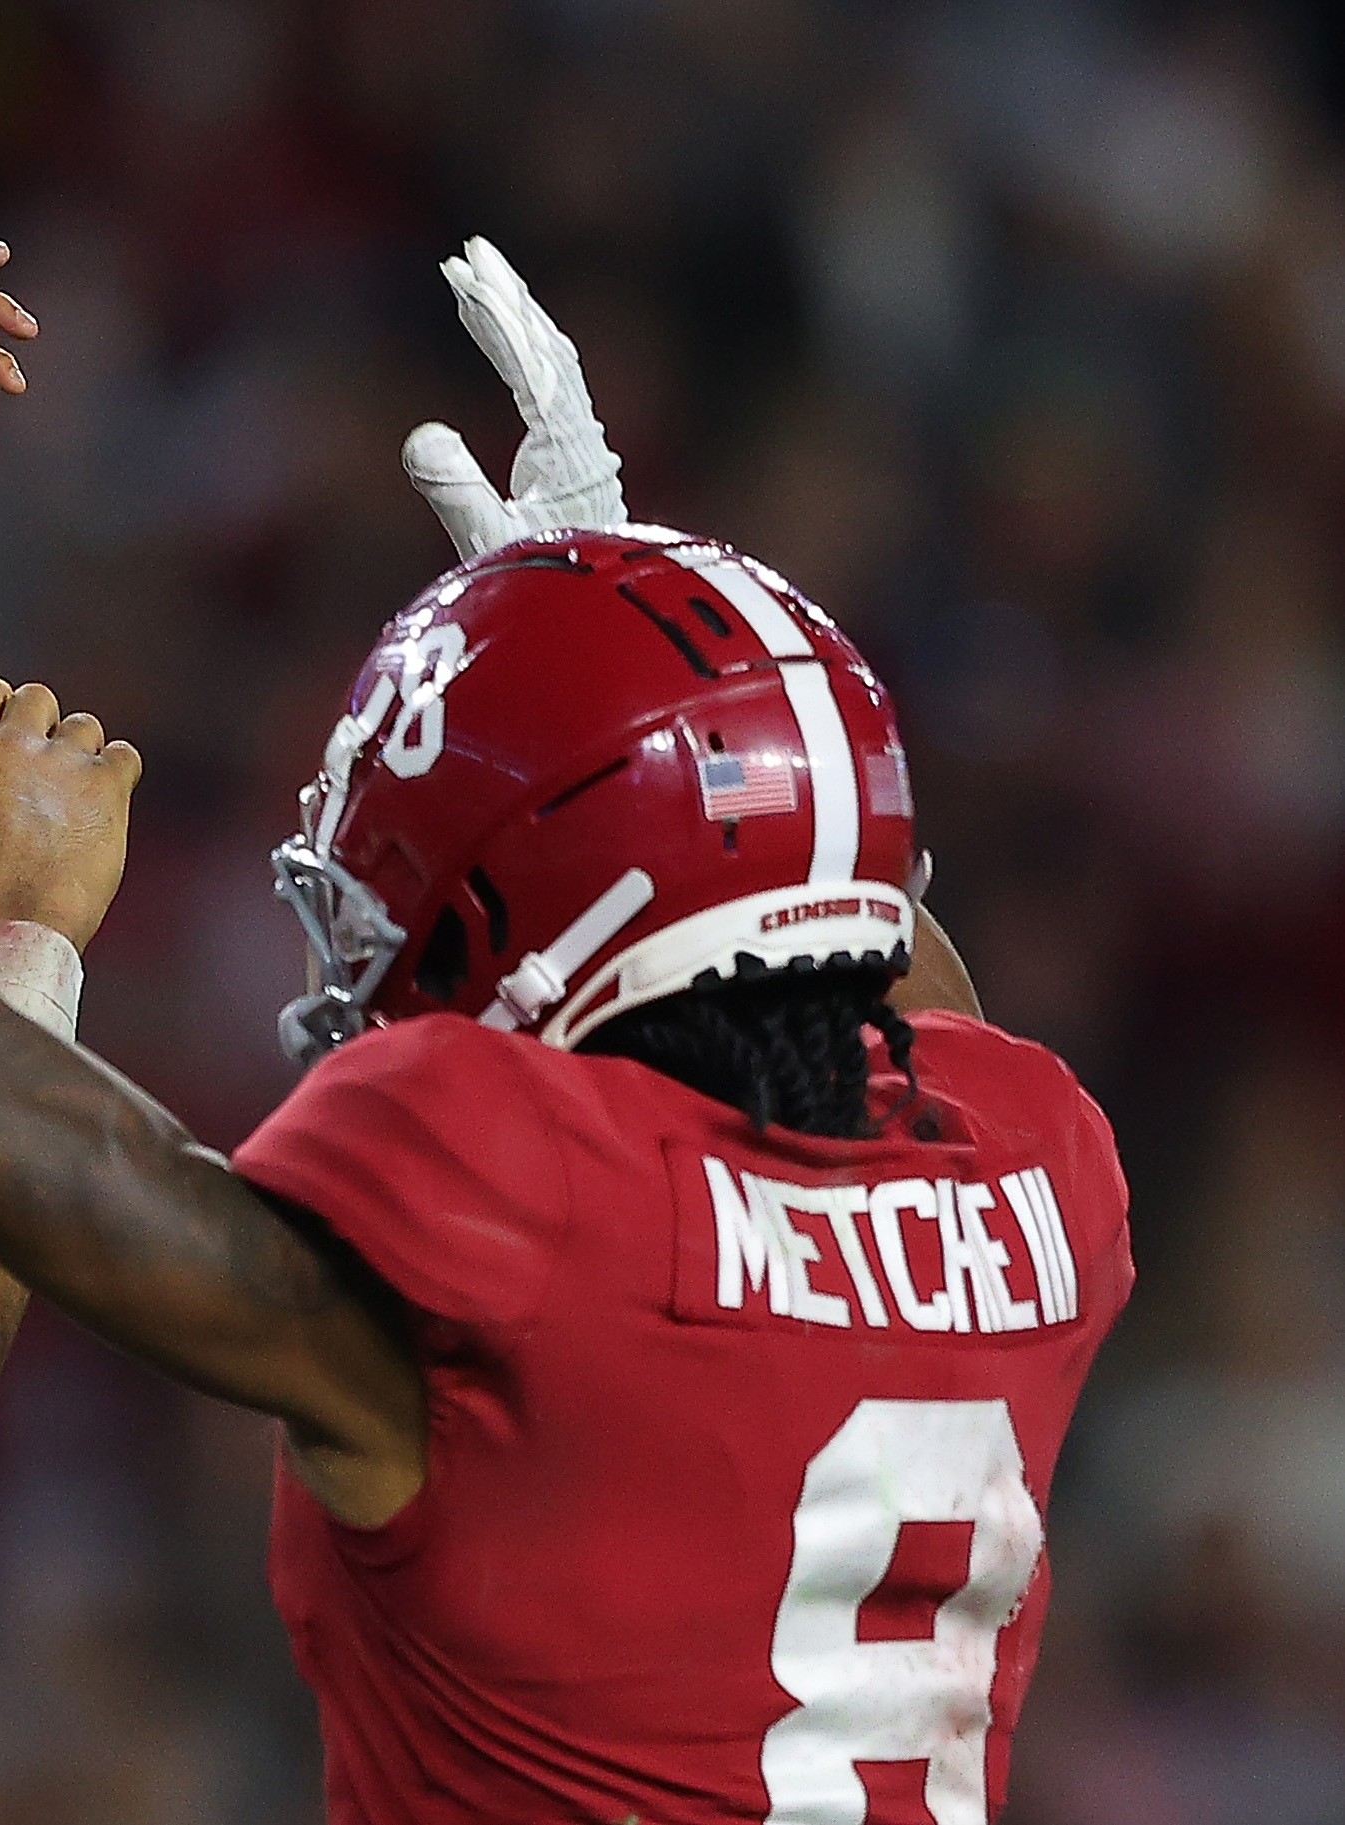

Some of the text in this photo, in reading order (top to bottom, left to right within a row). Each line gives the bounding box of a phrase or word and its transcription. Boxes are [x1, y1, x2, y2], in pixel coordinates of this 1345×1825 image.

[383, 621, 467, 780] 8
[760, 898, 861, 932] CRIM
[760, 1399, 1046, 1825] 8
